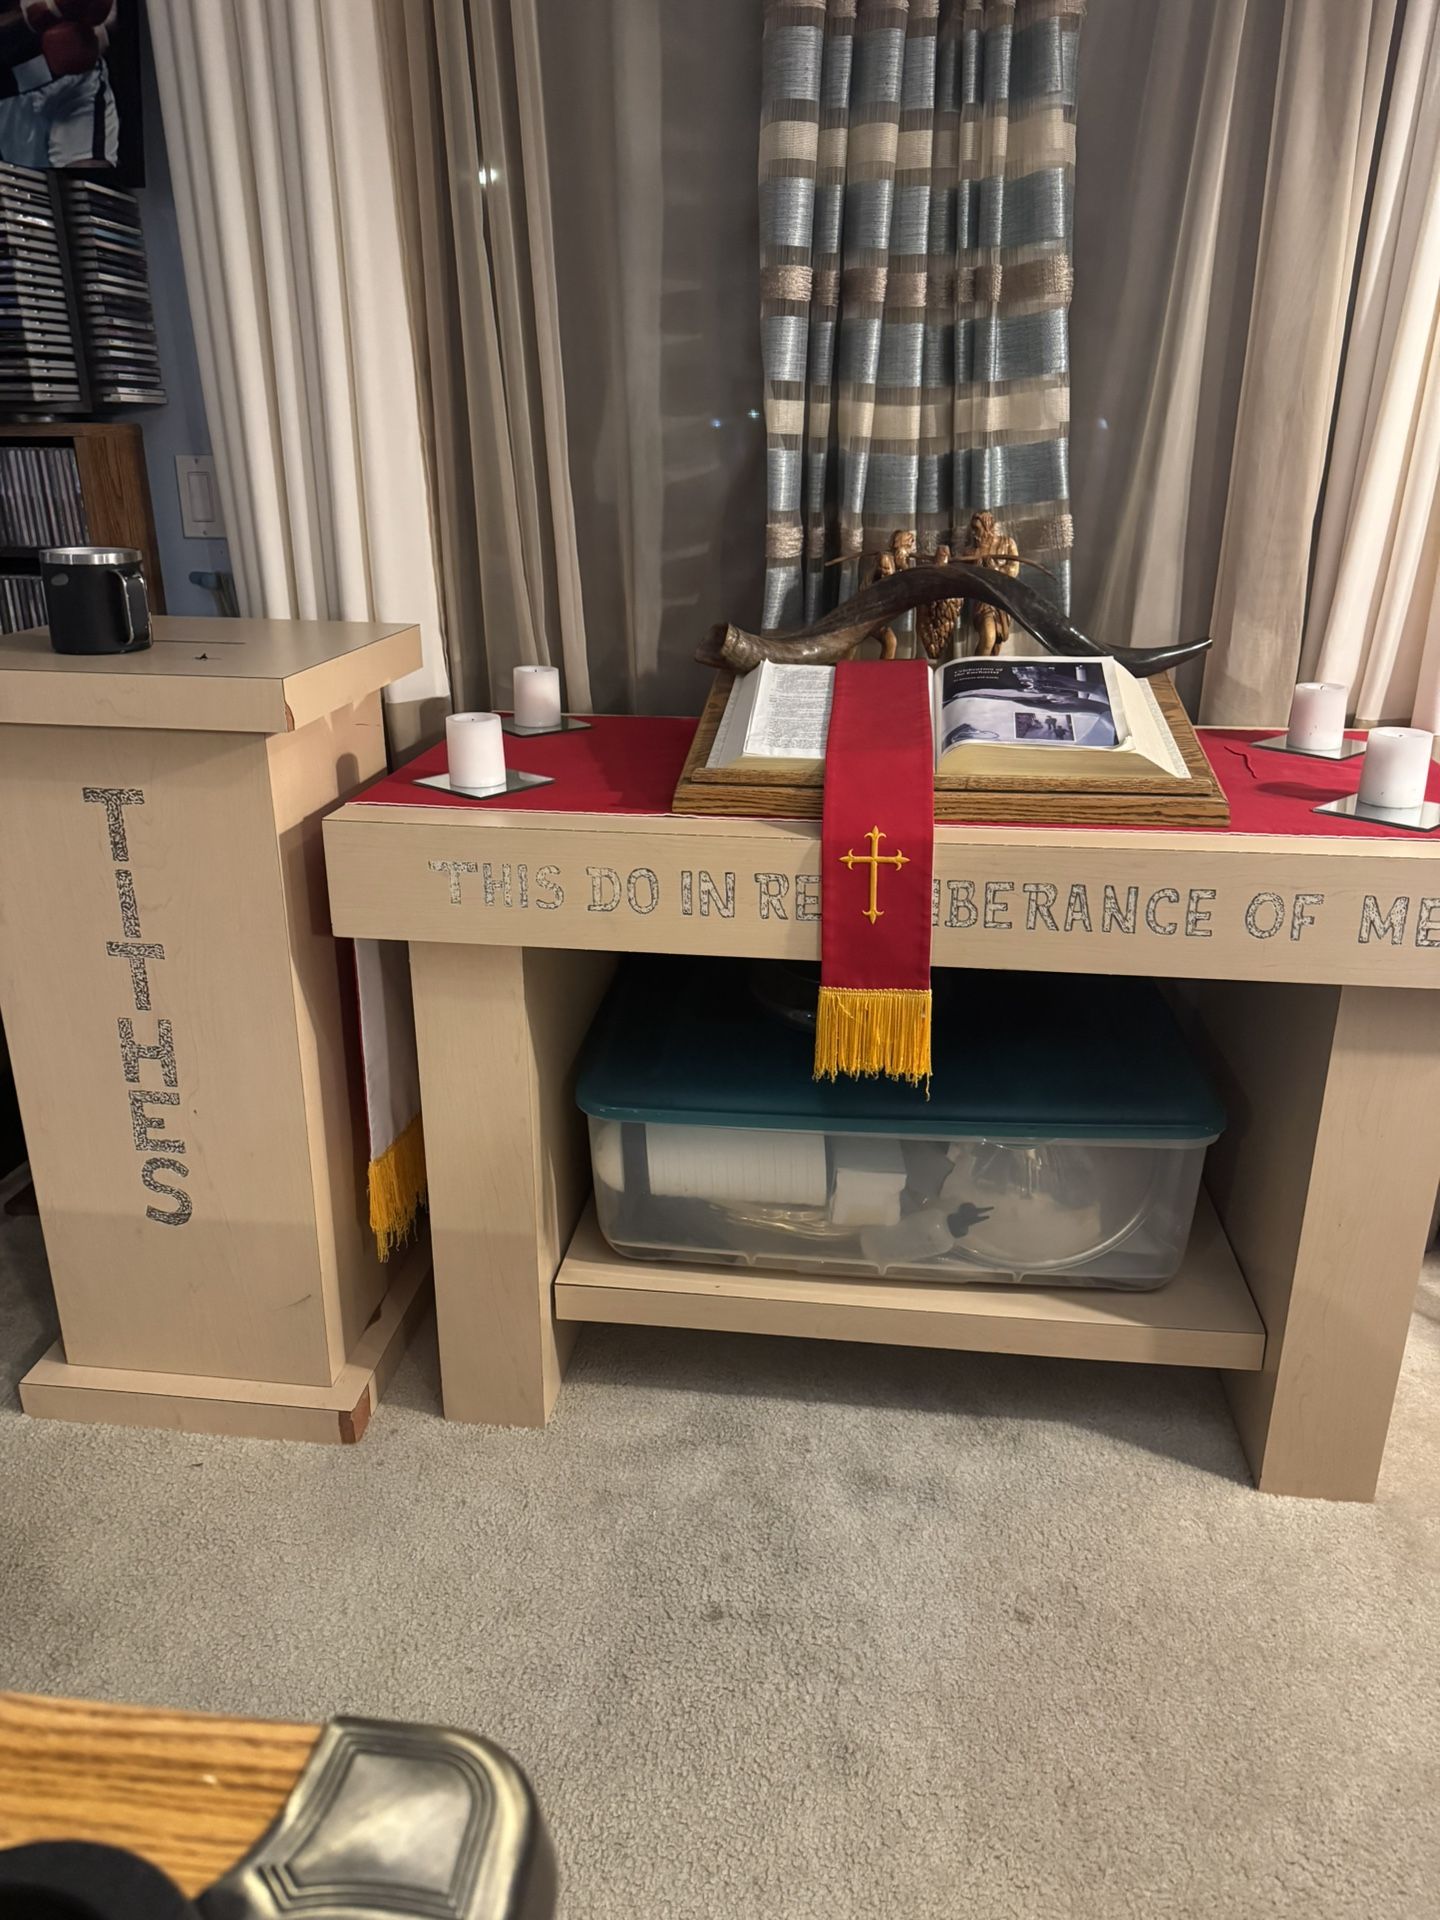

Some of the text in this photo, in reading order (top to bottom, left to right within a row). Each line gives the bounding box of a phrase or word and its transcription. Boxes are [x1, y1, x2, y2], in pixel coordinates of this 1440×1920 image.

[82, 786, 193, 1227] TITHES
[427, 860, 1440, 947] THIS DO IN REBERANCE OF ME
